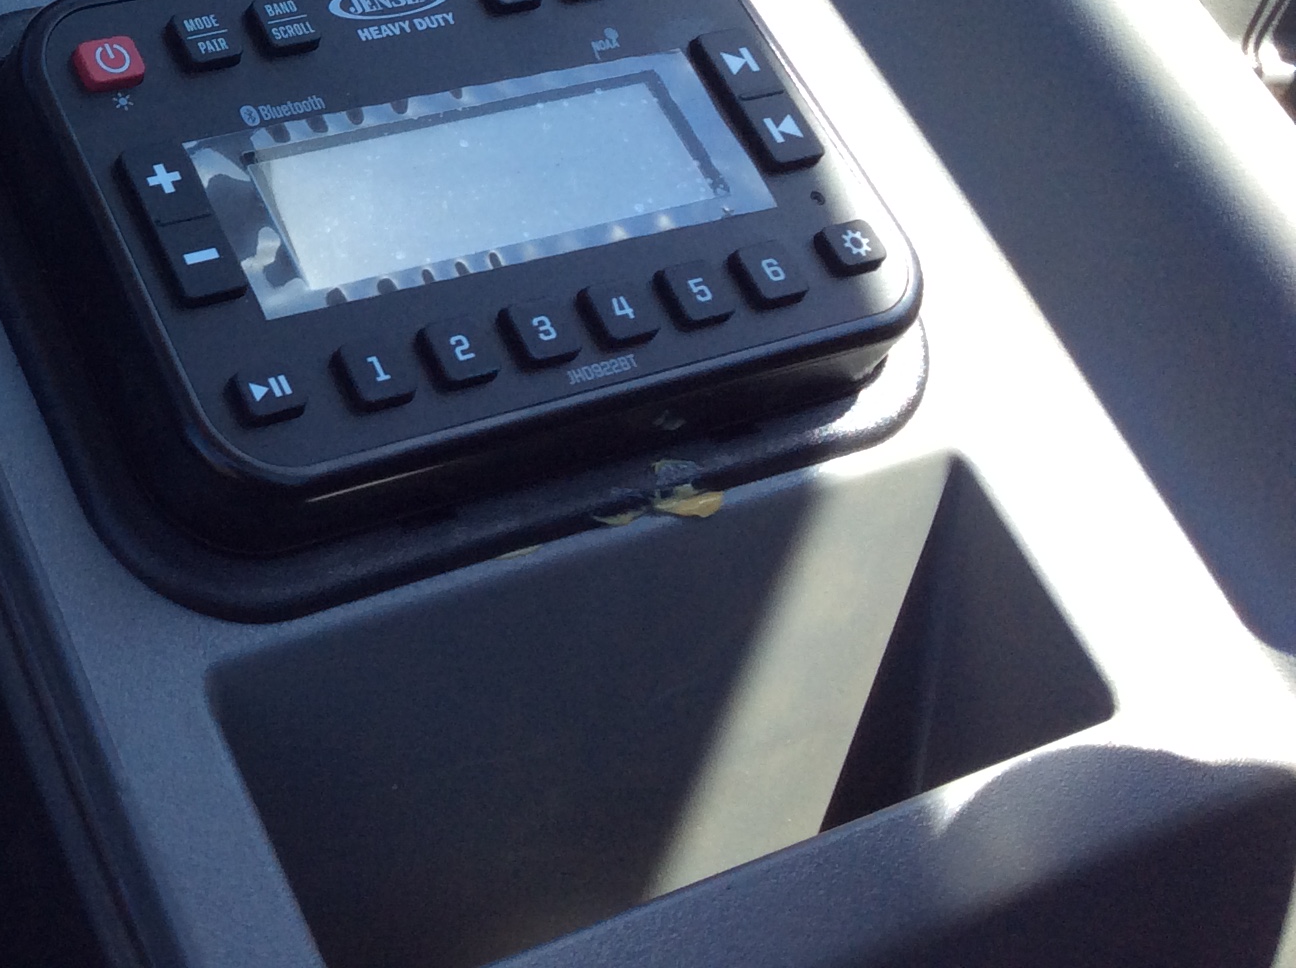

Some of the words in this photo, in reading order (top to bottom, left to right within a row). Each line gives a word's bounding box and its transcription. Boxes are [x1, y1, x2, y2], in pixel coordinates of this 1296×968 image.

[264, 0, 298, 18] BAND
[183, 13, 220, 33] MODE
[271, 20, 315, 41] SCROLL
[357, 19, 411, 42] HEAVY
[414, 12, 455, 31] DUTY
[198, 36, 229, 55] PAIR
[258, 94, 326, 122] Bluetooth
[761, 258, 786, 282] 6
[687, 277, 713, 303] 5
[611, 294, 636, 320] 4
[531, 314, 557, 342] 3
[449, 333, 476, 362] 2
[366, 355, 392, 383] 1
